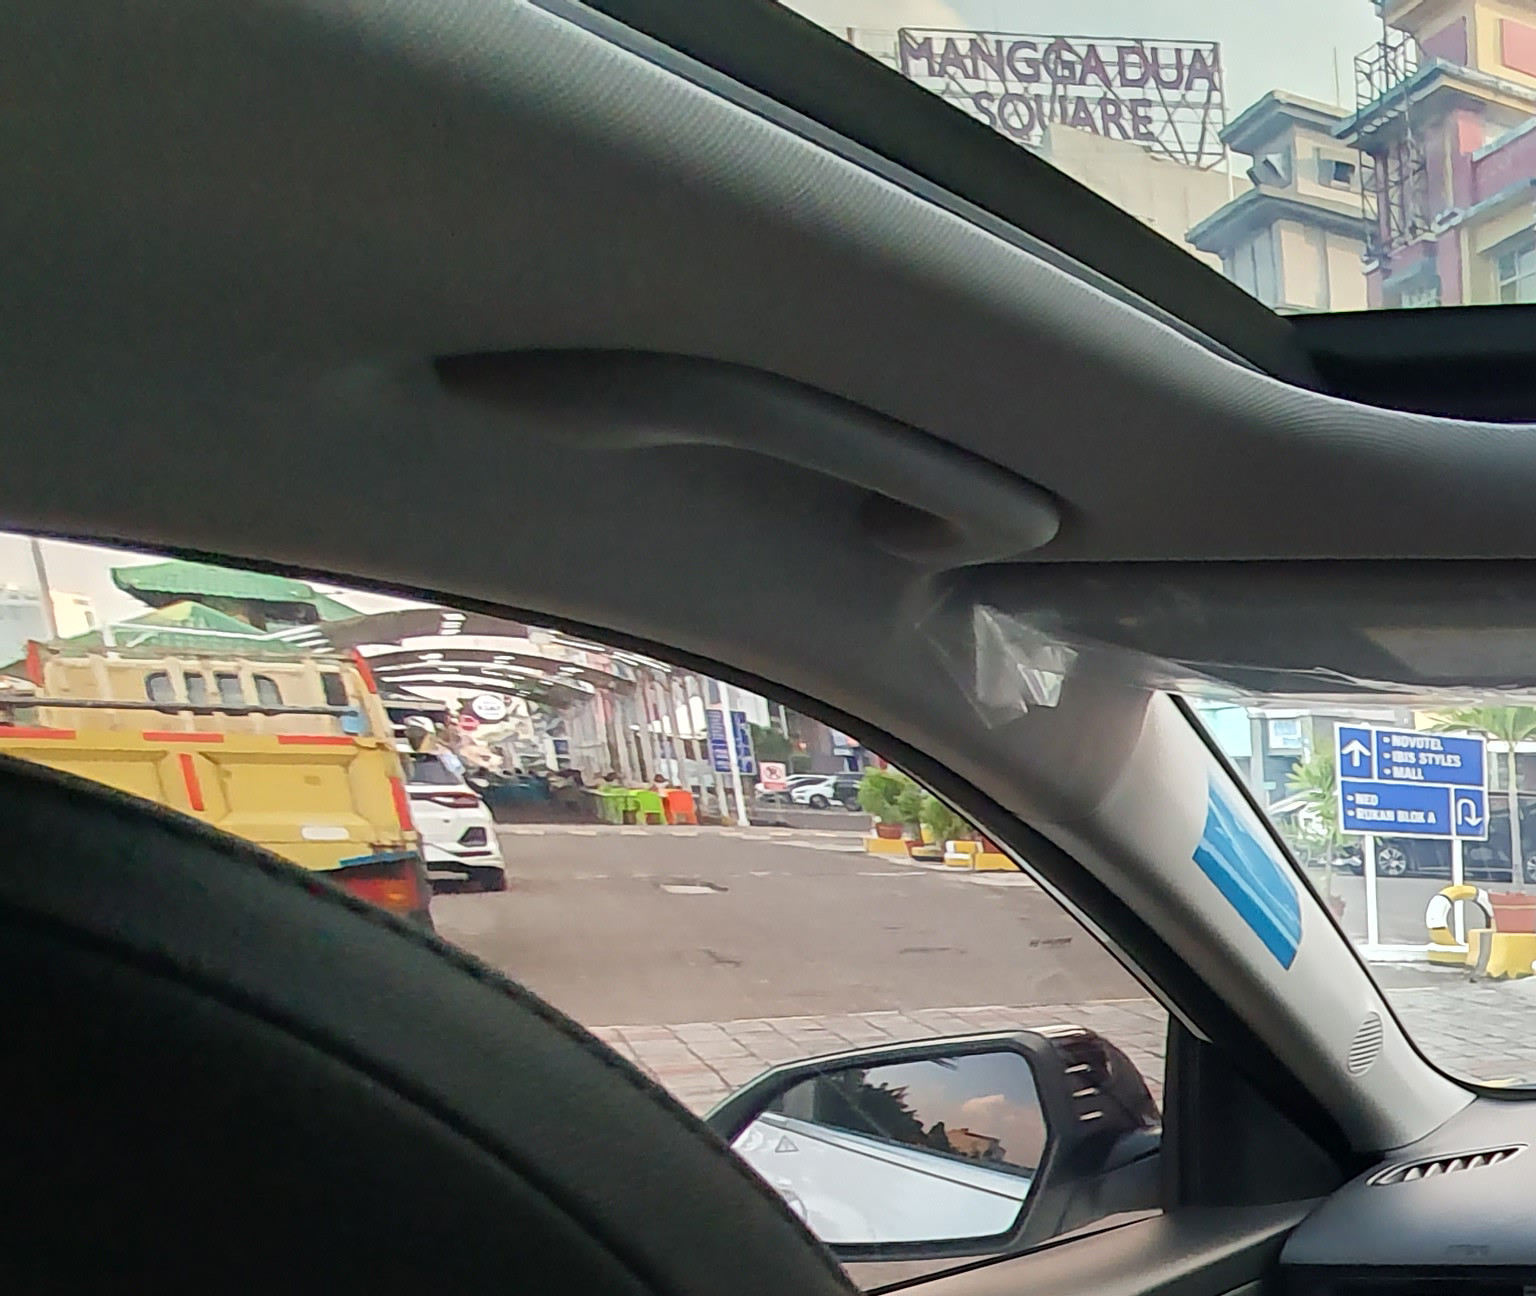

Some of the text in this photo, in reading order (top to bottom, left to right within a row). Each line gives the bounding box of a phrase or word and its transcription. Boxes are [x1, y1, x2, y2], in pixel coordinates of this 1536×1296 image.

[901, 36, 1219, 92] MANGGA DUA
[972, 90, 1158, 142] SQUARE
[1391, 734, 1443, 750] NOVOTEL
[1418, 752, 1462, 768] STYLES
[1391, 765, 1425, 780] MALL
[1427, 811, 1437, 824] A
